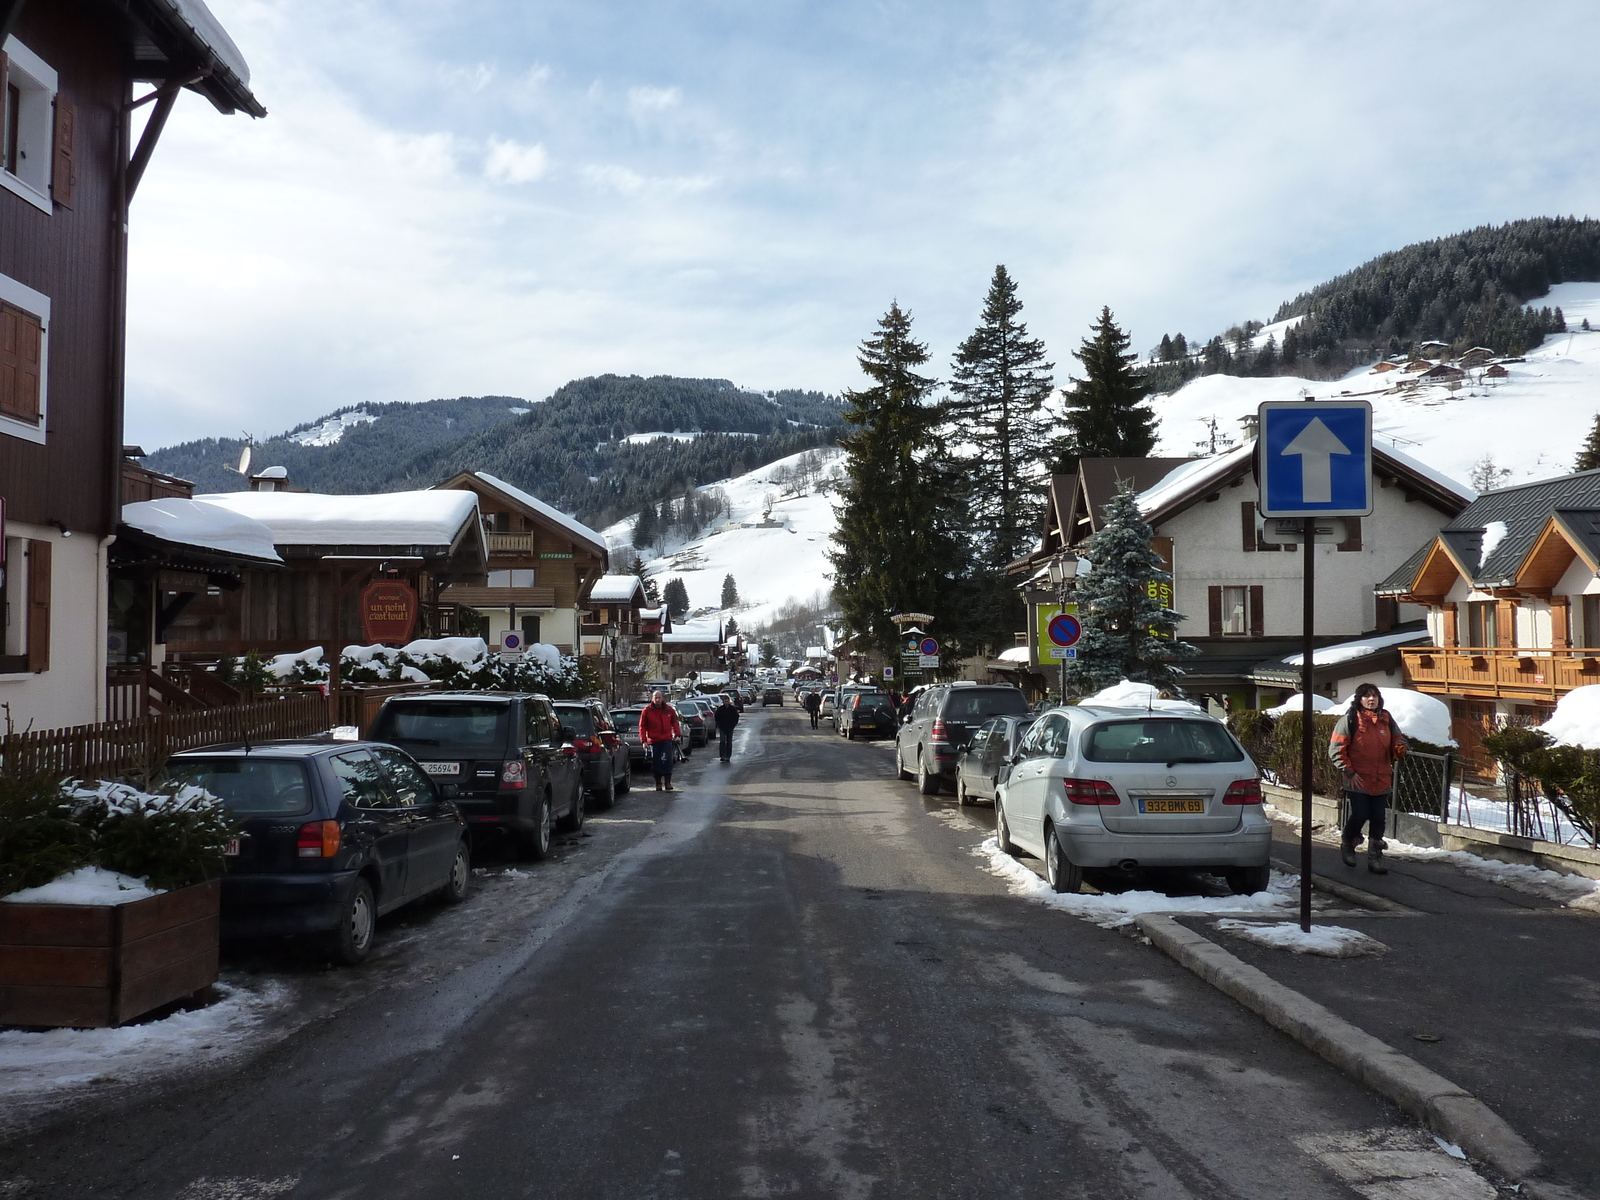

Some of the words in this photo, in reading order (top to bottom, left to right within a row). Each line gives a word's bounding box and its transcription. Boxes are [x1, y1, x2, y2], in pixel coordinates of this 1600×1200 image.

[370, 604, 383, 612] un
[385, 602, 407, 613] point
[428, 763, 452, 773] 25694
[1147, 801, 1167, 812] 932
[1167, 801, 1186, 812] BMK
[1188, 801, 1201, 812] 69
